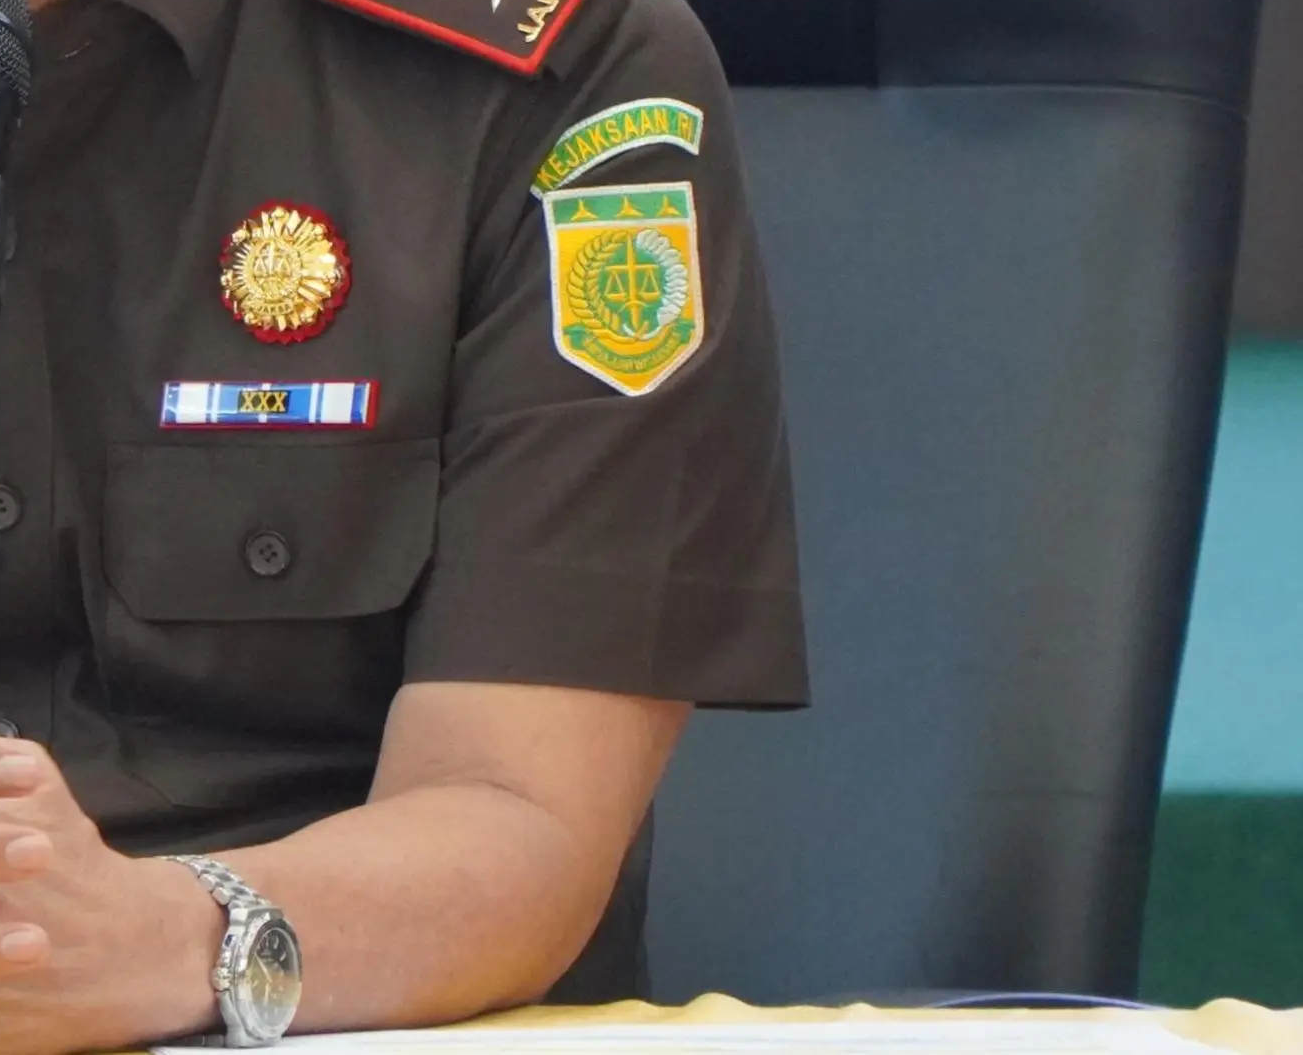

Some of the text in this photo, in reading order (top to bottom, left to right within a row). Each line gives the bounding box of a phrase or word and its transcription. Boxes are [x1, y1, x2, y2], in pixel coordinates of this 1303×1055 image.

[537, 108, 693, 189] KEJAKSAAN RI
[240, 390, 288, 413] XXX
